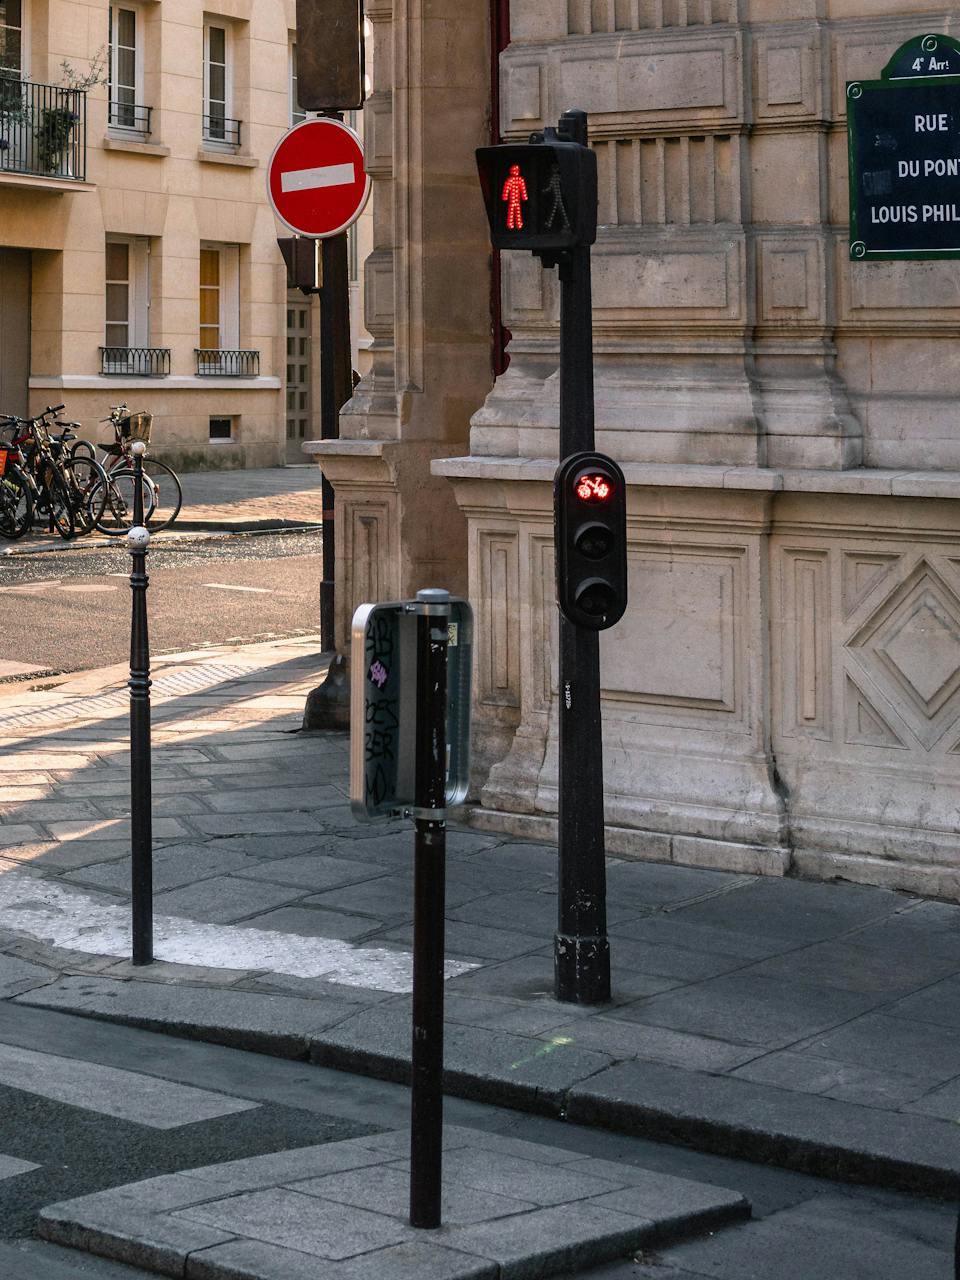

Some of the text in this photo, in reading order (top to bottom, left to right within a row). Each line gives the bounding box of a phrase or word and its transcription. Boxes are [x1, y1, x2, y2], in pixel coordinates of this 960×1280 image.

[915, 114, 948, 132] RUE
[898, 158, 960, 178] DU PON
[871, 204, 960, 223] LOUIS PHIL
